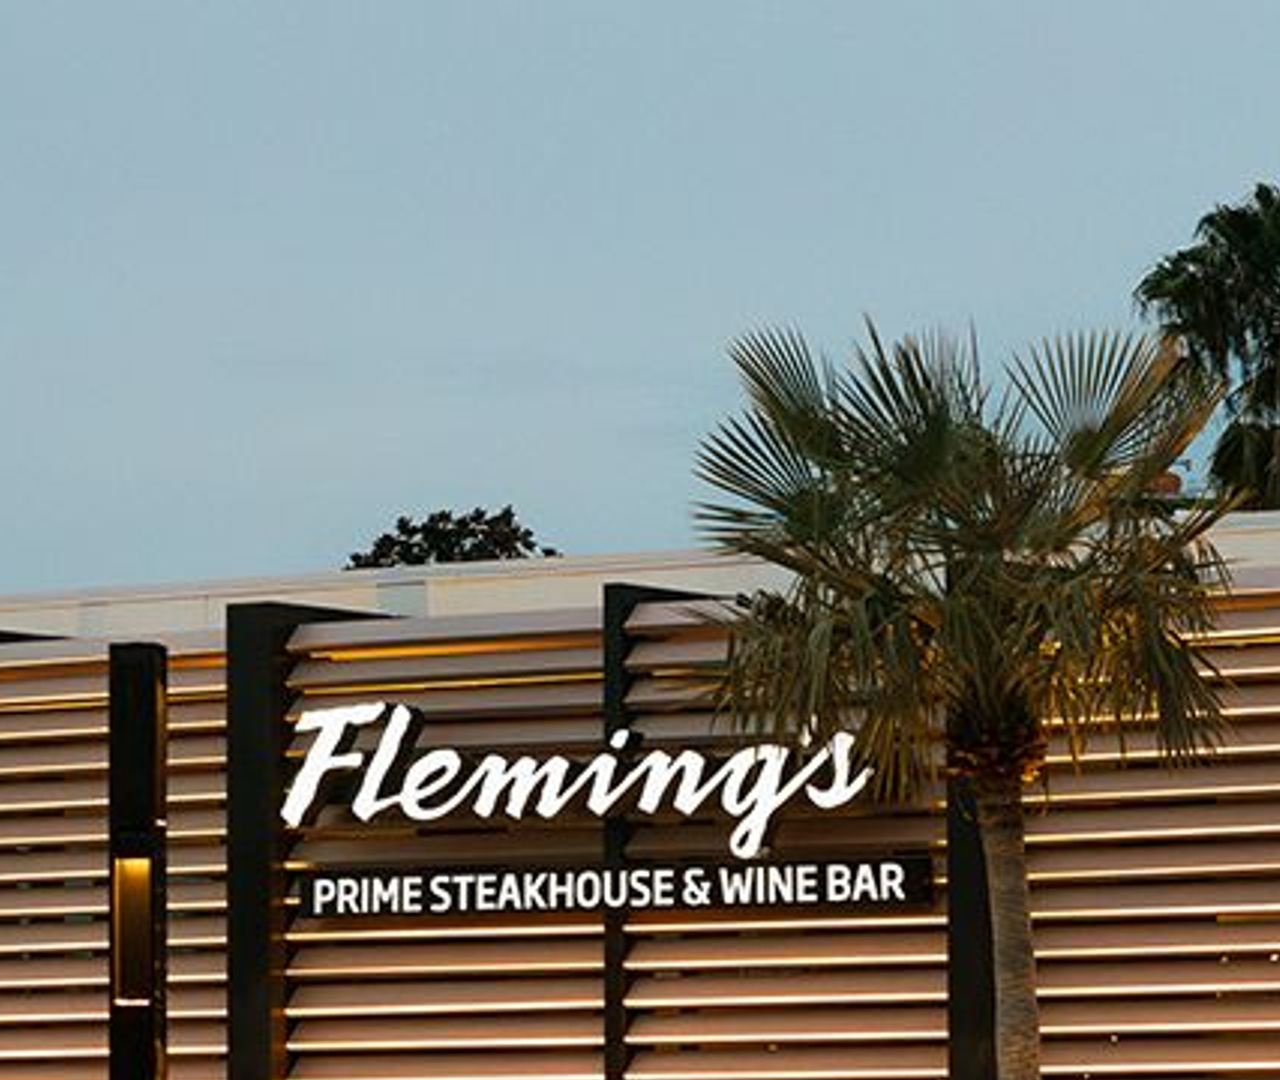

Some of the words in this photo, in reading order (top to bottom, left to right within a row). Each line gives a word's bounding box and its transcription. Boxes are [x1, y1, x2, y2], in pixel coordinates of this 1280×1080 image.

[313, 876, 424, 915] PRIME
[429, 868, 676, 913] STEAKHOUSE
[682, 867, 712, 907] &
[719, 864, 819, 905] WINE
[826, 861, 907, 902] BAR
